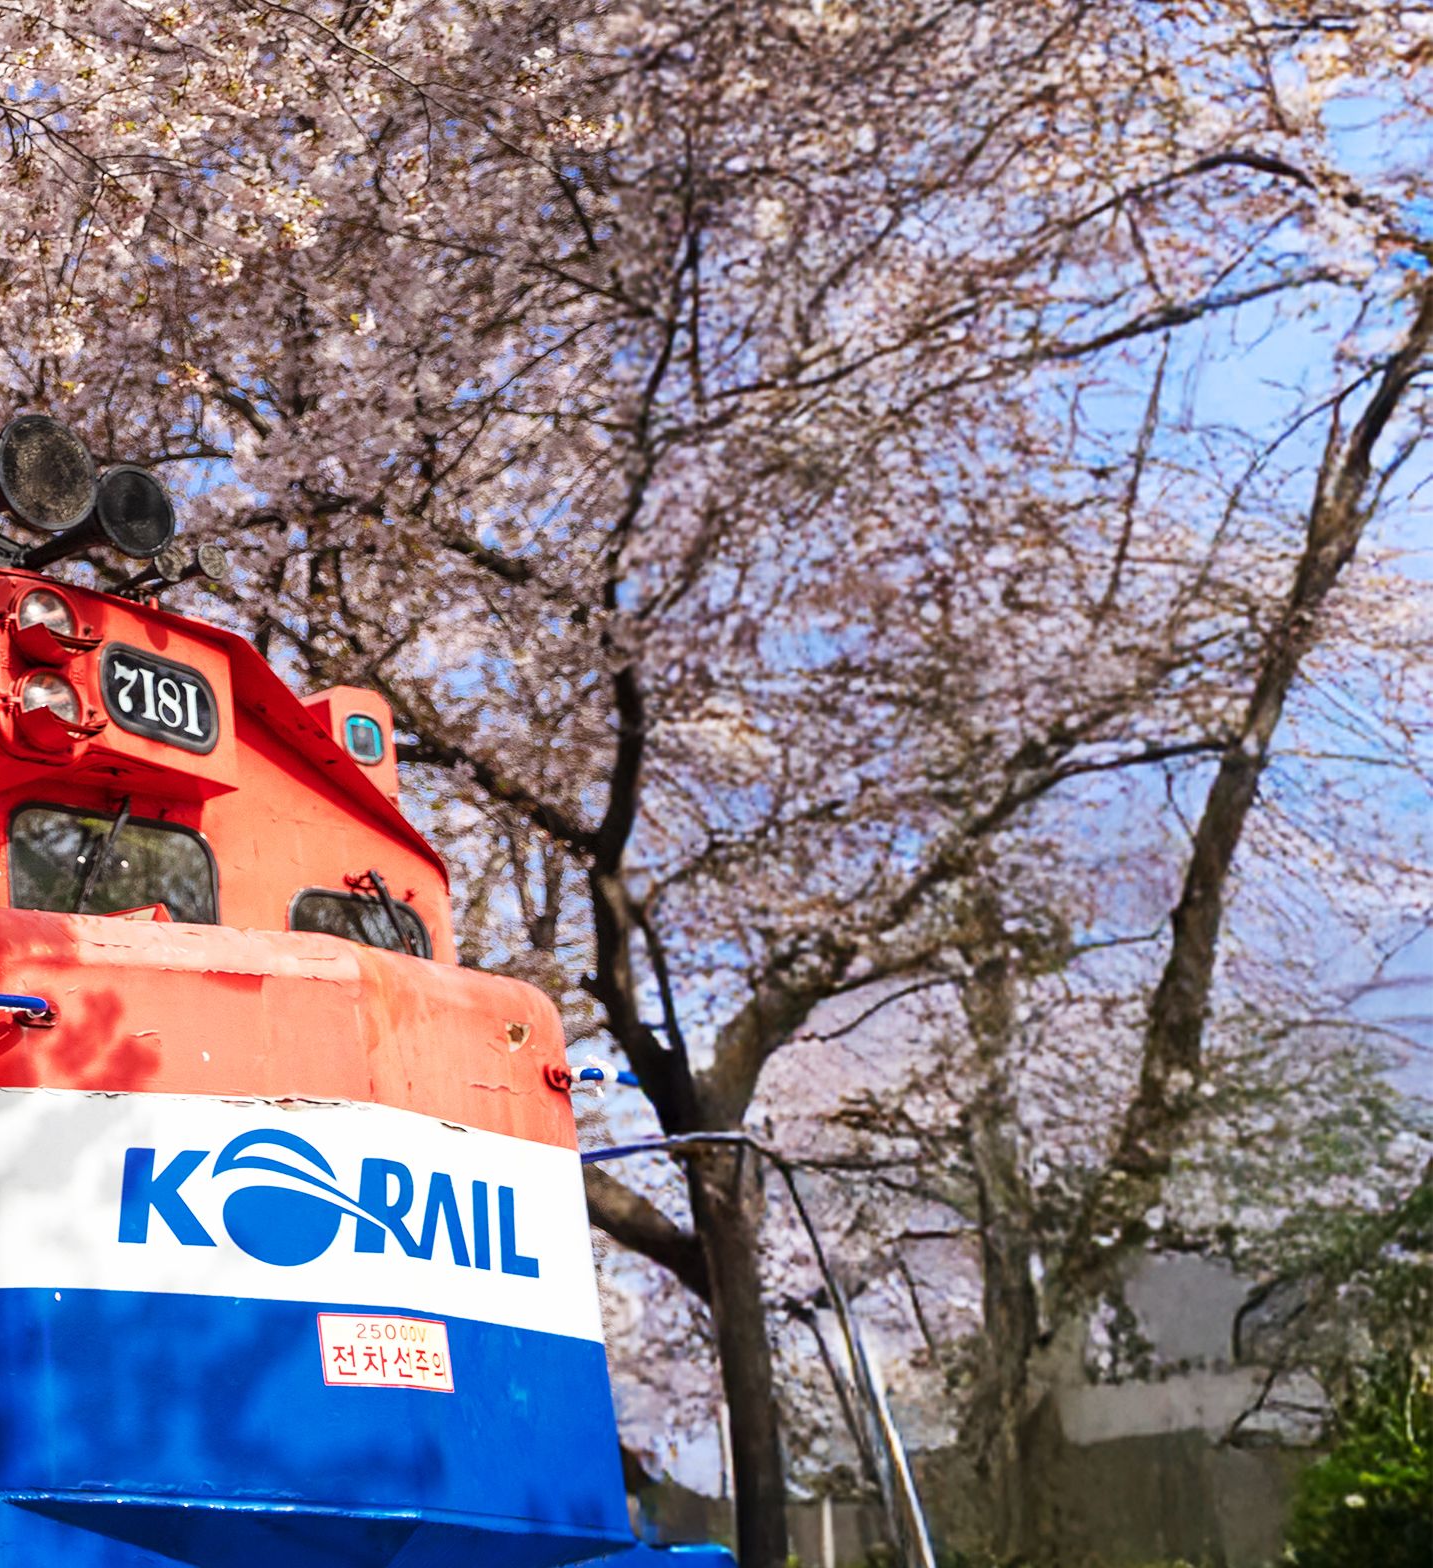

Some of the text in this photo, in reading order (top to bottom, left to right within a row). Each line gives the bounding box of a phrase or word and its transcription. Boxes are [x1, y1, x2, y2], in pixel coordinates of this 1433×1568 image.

[113, 660, 204, 737] 7181
[118, 1128, 540, 1278] KORAIL
[356, 1323, 426, 1343] 25000V
[333, 1345, 447, 1383] 전차선주의
